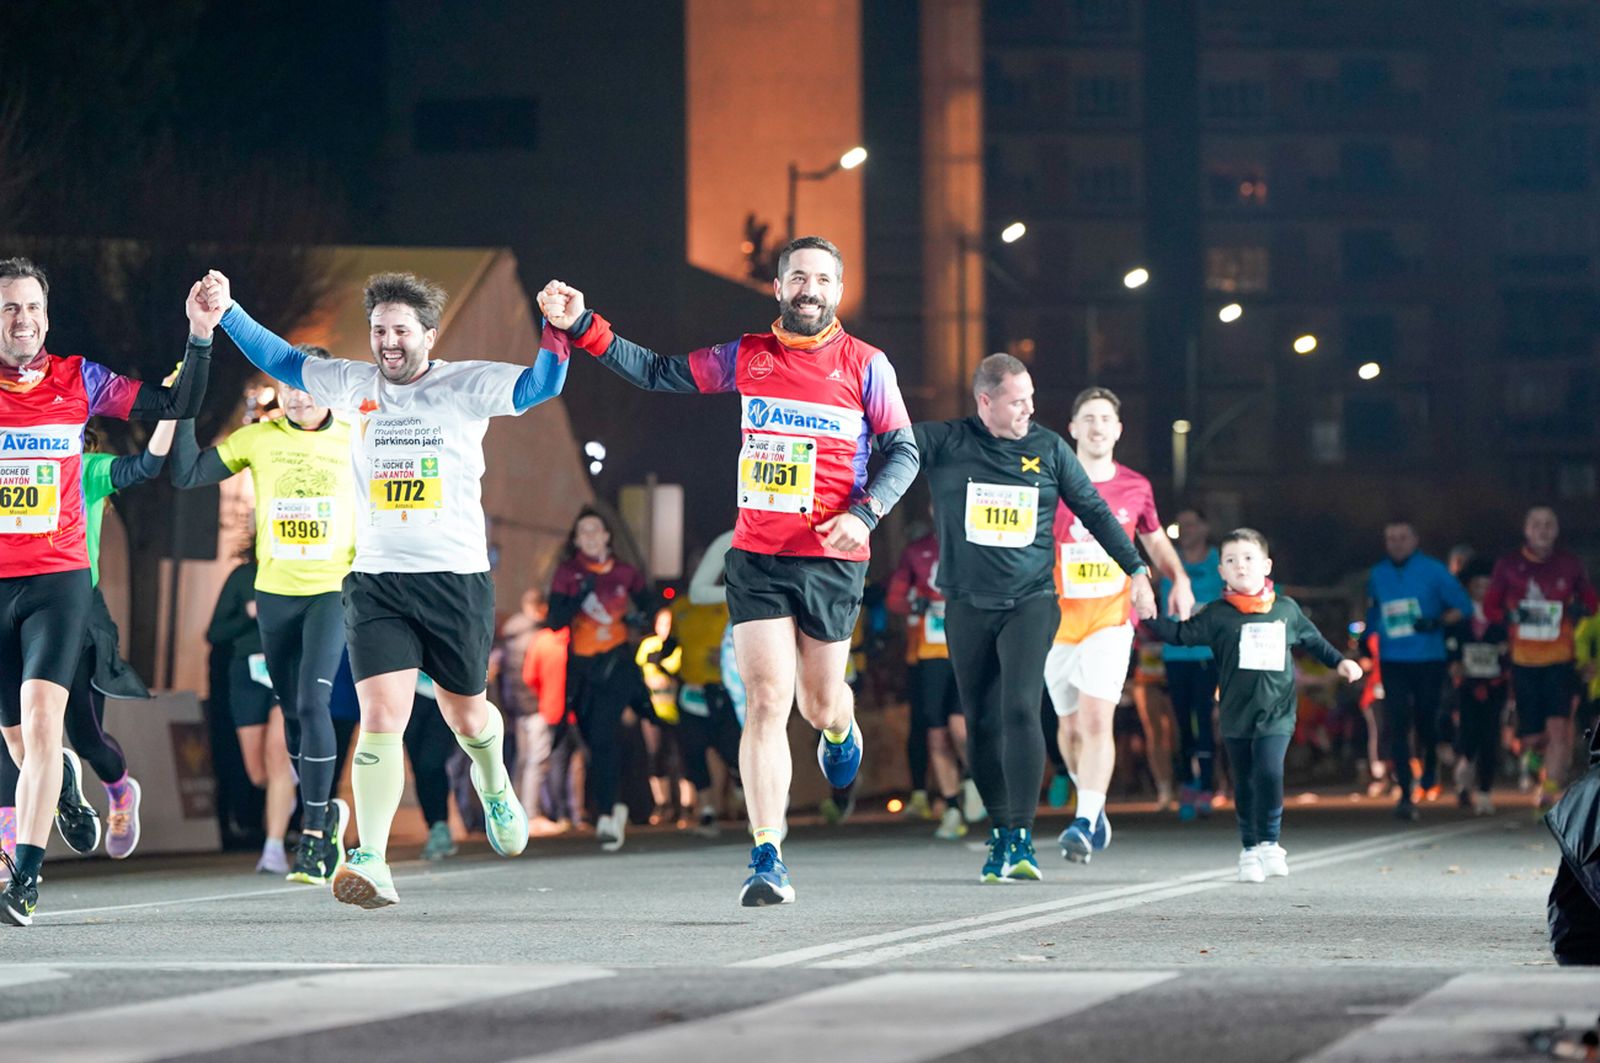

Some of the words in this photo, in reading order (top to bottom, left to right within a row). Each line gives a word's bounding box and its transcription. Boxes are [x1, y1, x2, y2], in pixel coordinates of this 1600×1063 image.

[376, 417, 421, 427] asociación
[770, 408, 841, 432] Avanza
[433, 426, 442, 434] el
[2, 434, 69, 451] Avanza
[375, 437, 421, 447] párkinson
[422, 436, 444, 446] jaén
[21, 468, 30, 476] DE
[382, 462, 403, 470] NOCHE
[405, 461, 414, 469] DE
[752, 461, 798, 487] 4051
[0, 486, 38, 508] 620
[384, 480, 425, 502] 1772
[985, 507, 1019, 526] 1114
[279, 520, 328, 538] 13987
[1078, 563, 1110, 578] 4712
